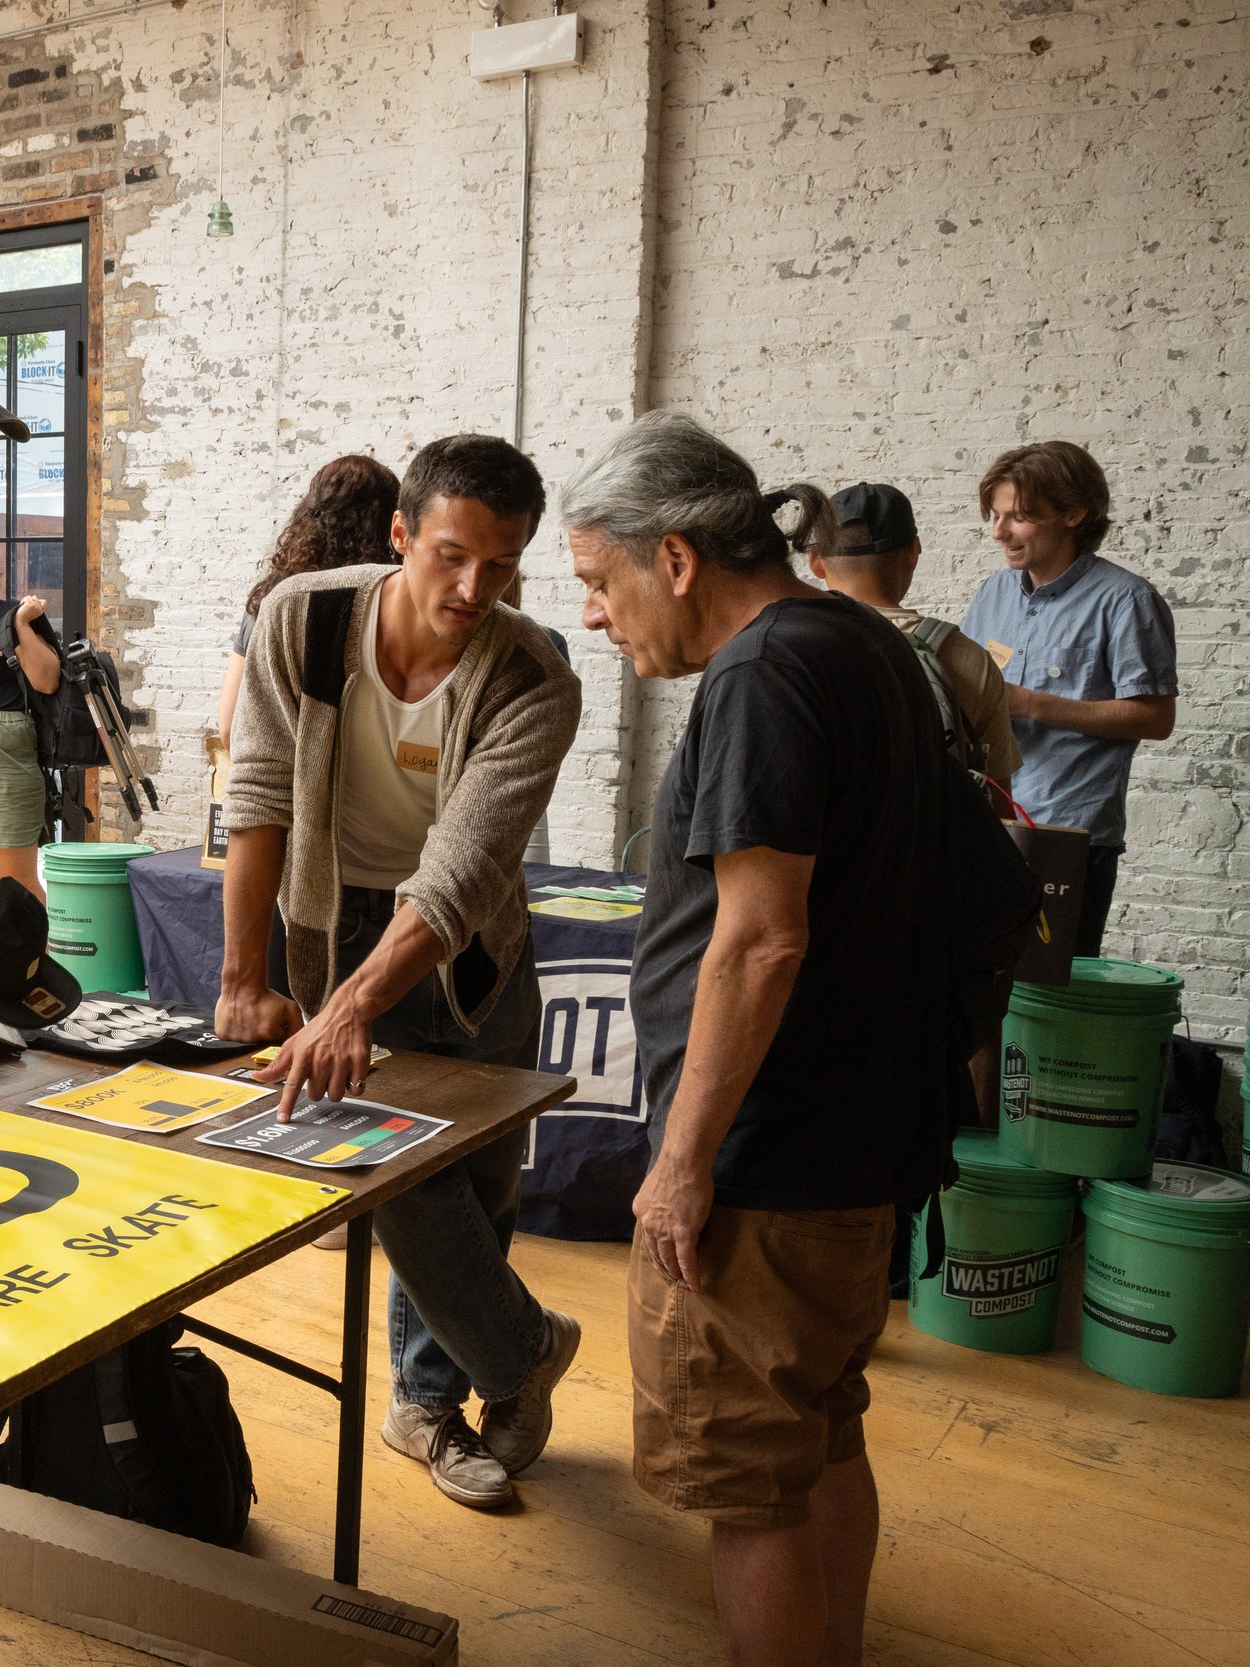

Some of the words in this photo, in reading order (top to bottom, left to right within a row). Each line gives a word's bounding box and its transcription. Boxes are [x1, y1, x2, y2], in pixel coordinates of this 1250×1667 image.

[1038, 1065, 1080, 1080] WITHOUT
[1081, 1072, 1139, 1083] COMPROMISE
[1053, 1057, 1097, 1071] COMPOST
[63, 1088, 127, 1111] $800K
[235, 1124, 297, 1147] $1.6M
[62, 1194, 220, 1258] SKATE
[950, 1254, 1059, 1293] WASTENOT
[1095, 1258, 1126, 1276] COMPOST
[1112, 1277, 1172, 1298] COMPROMISE
